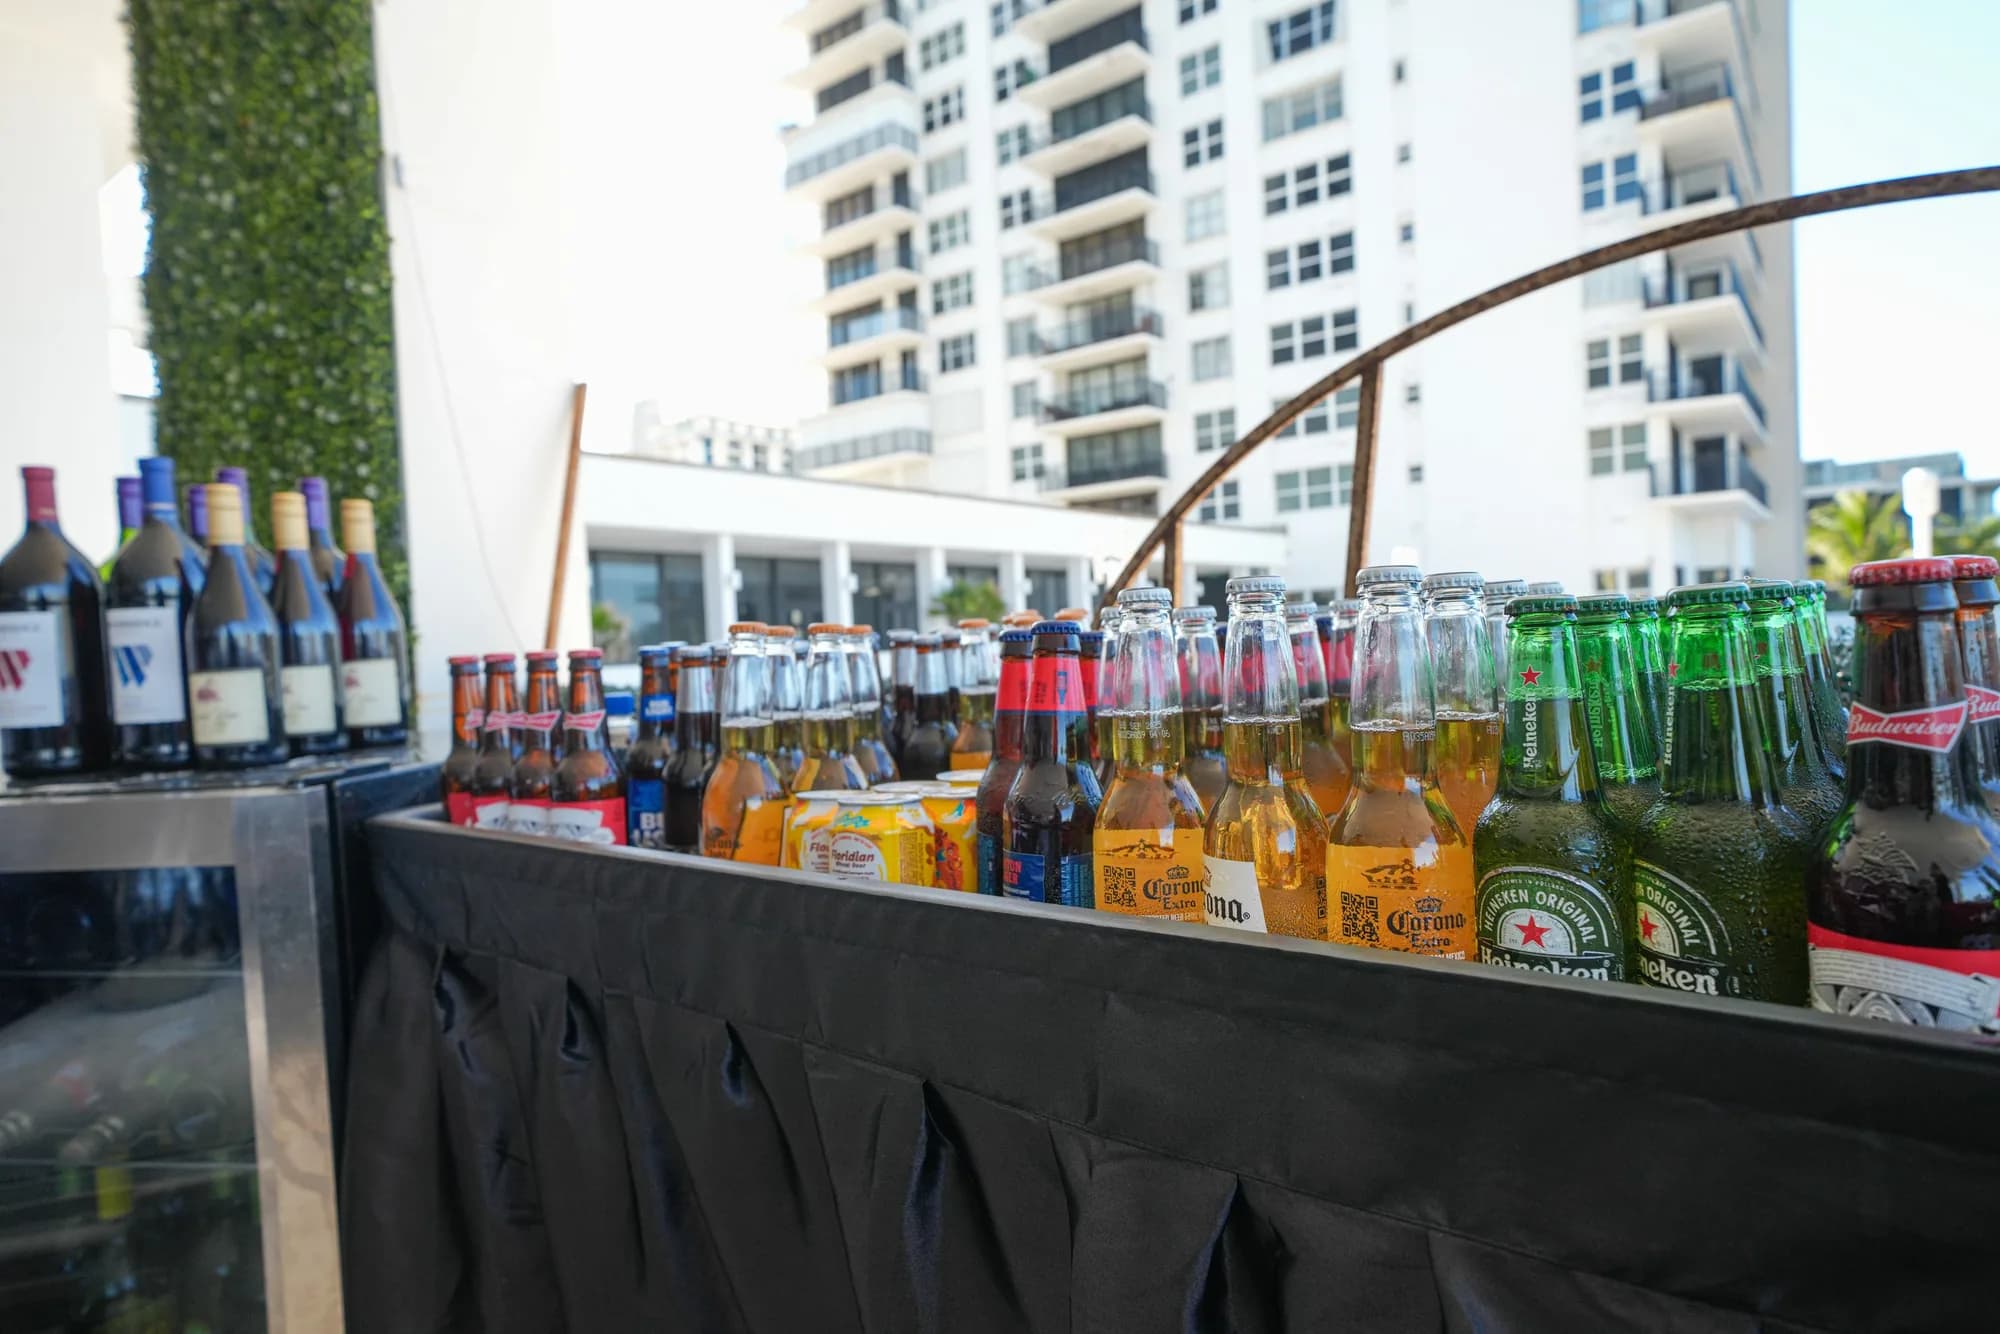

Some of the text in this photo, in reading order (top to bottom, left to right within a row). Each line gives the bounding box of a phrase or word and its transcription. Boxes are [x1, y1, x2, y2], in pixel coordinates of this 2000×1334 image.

[1523, 692, 1538, 769] Heineken
[1664, 686, 1676, 766] Heineken
[1849, 713, 1958, 736] Budweiser
[1387, 911, 1466, 938] Corona
[1484, 889, 1597, 943] HEINEKEN ORIGINAL
[1646, 886, 1700, 946] ORIGINAL
